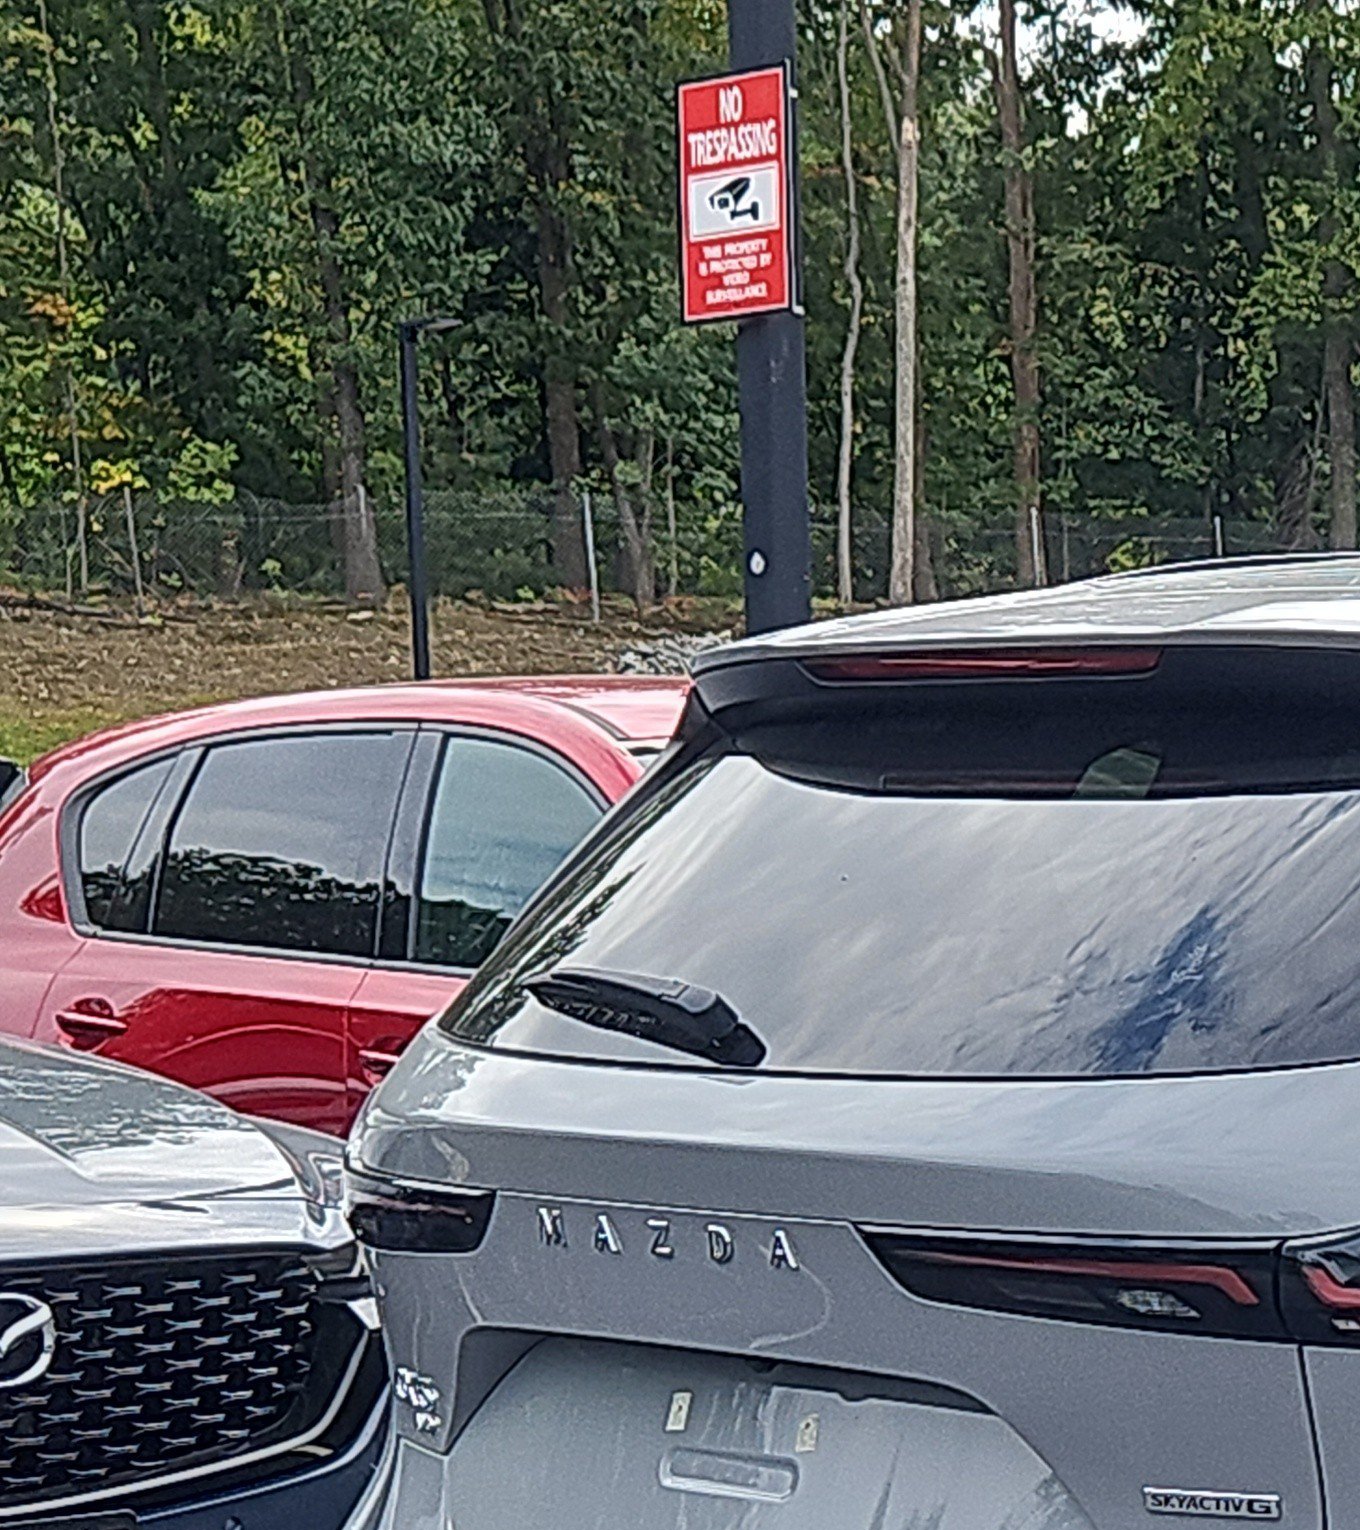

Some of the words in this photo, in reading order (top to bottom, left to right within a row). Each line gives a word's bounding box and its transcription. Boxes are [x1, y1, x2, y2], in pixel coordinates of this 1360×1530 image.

[719, 85, 742, 124] NO
[688, 118, 777, 167] TRESPASSING
[537, 1206, 799, 1271] MAZDA
